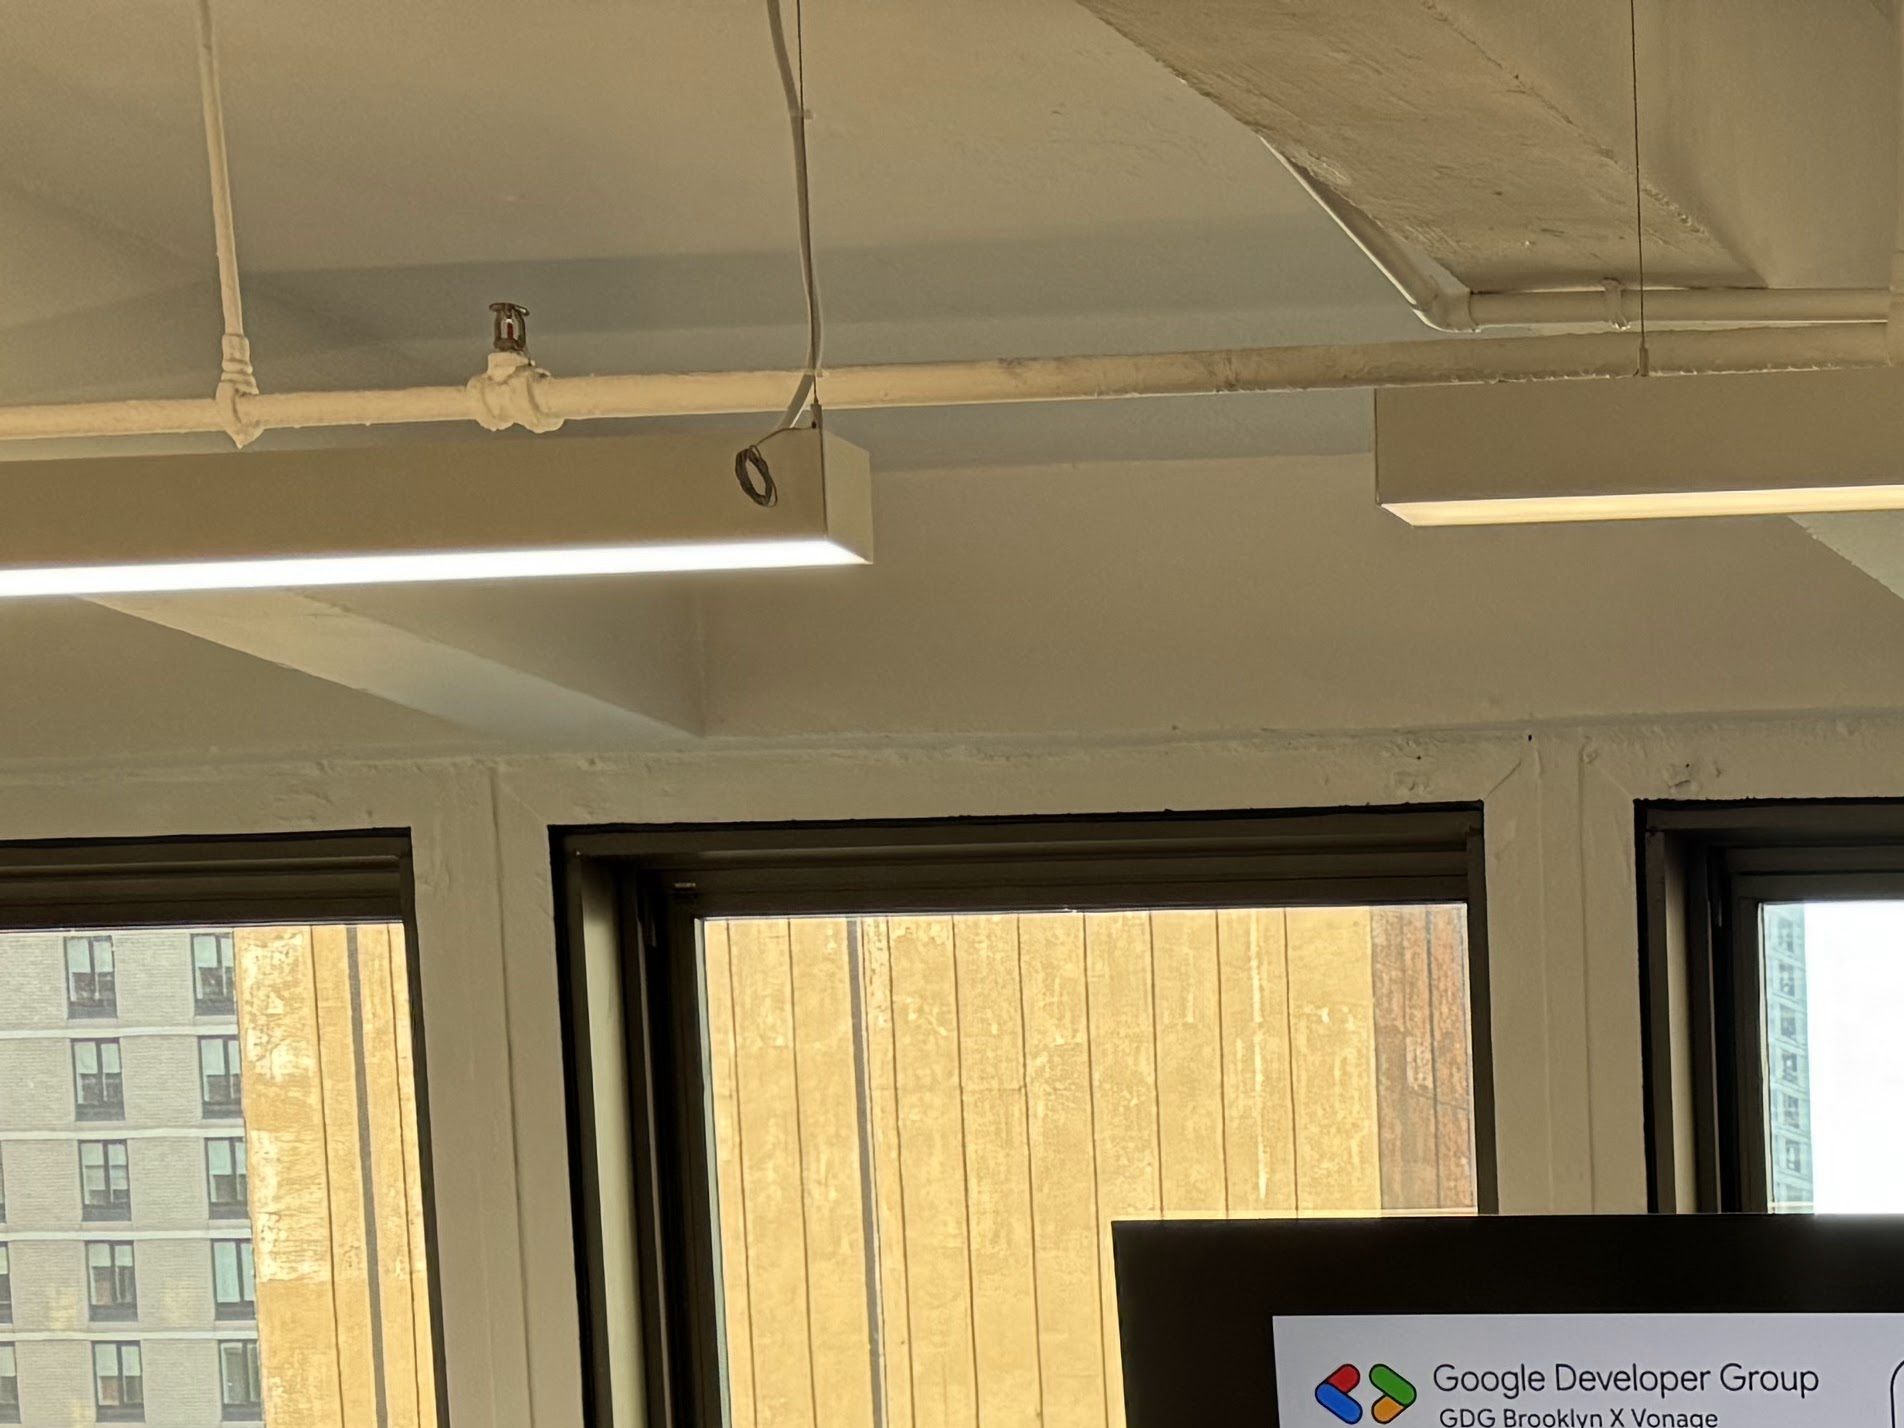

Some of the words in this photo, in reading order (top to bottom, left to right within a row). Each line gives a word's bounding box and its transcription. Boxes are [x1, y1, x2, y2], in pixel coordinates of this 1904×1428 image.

[1433, 1363, 1546, 1399] Google
[1555, 1362, 1712, 1399] Developer
[1719, 1362, 1820, 1399] Group
[1439, 1408, 1496, 1428] GDG
[1609, 1408, 1626, 1428] X
